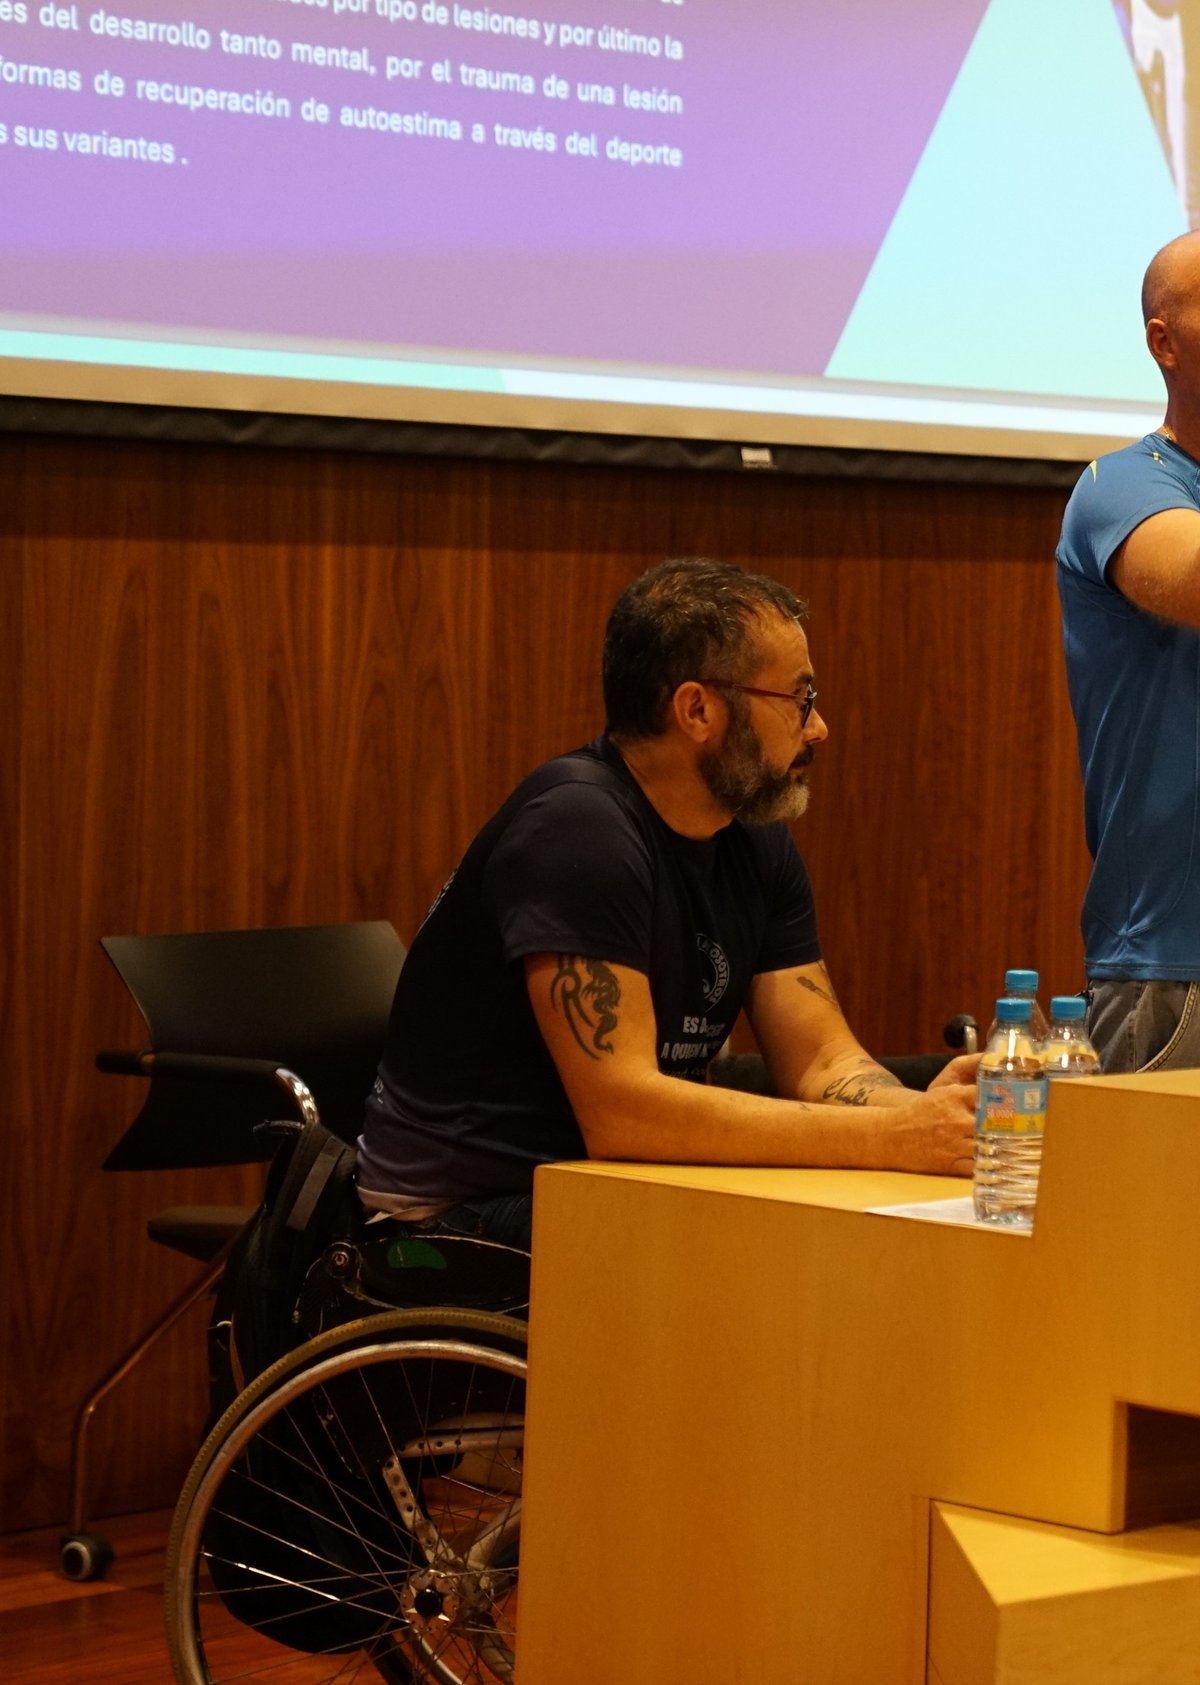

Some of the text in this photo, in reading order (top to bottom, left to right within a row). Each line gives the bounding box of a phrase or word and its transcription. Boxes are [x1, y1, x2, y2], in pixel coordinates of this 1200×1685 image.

[376, 0, 416, 22] tipo
[421, 1, 448, 25] de
[453, 3, 541, 39] lesiones
[543, 21, 556, 45] y
[559, 23, 593, 47] por
[598, 25, 660, 57] último
[665, 35, 684, 60] la
[39, 2, 78, 30] del
[90, 9, 210, 49] desarrollo
[220, 30, 281, 59] tanto
[291, 42, 376, 75] mental,
[386, 55, 423, 80] por
[431, 59, 452, 82] el
[460, 63, 534, 94] trauma
[543, 73, 569, 99] de
[577, 82, 615, 105] una
[623, 83, 683, 114] lesión
[14, 125, 57, 150] sus
[94, 70, 124, 97] de
[137, 80, 290, 118] recuperación
[301, 97, 329, 123] de
[340, 106, 462, 140] autoestima
[472, 123, 485, 143] a
[494, 122, 556, 152] través
[565, 132, 598, 157] del
[605, 136, 683, 167] deporte
[683, 1016, 699, 1033] ES
[661, 1042, 670, 1058] A
